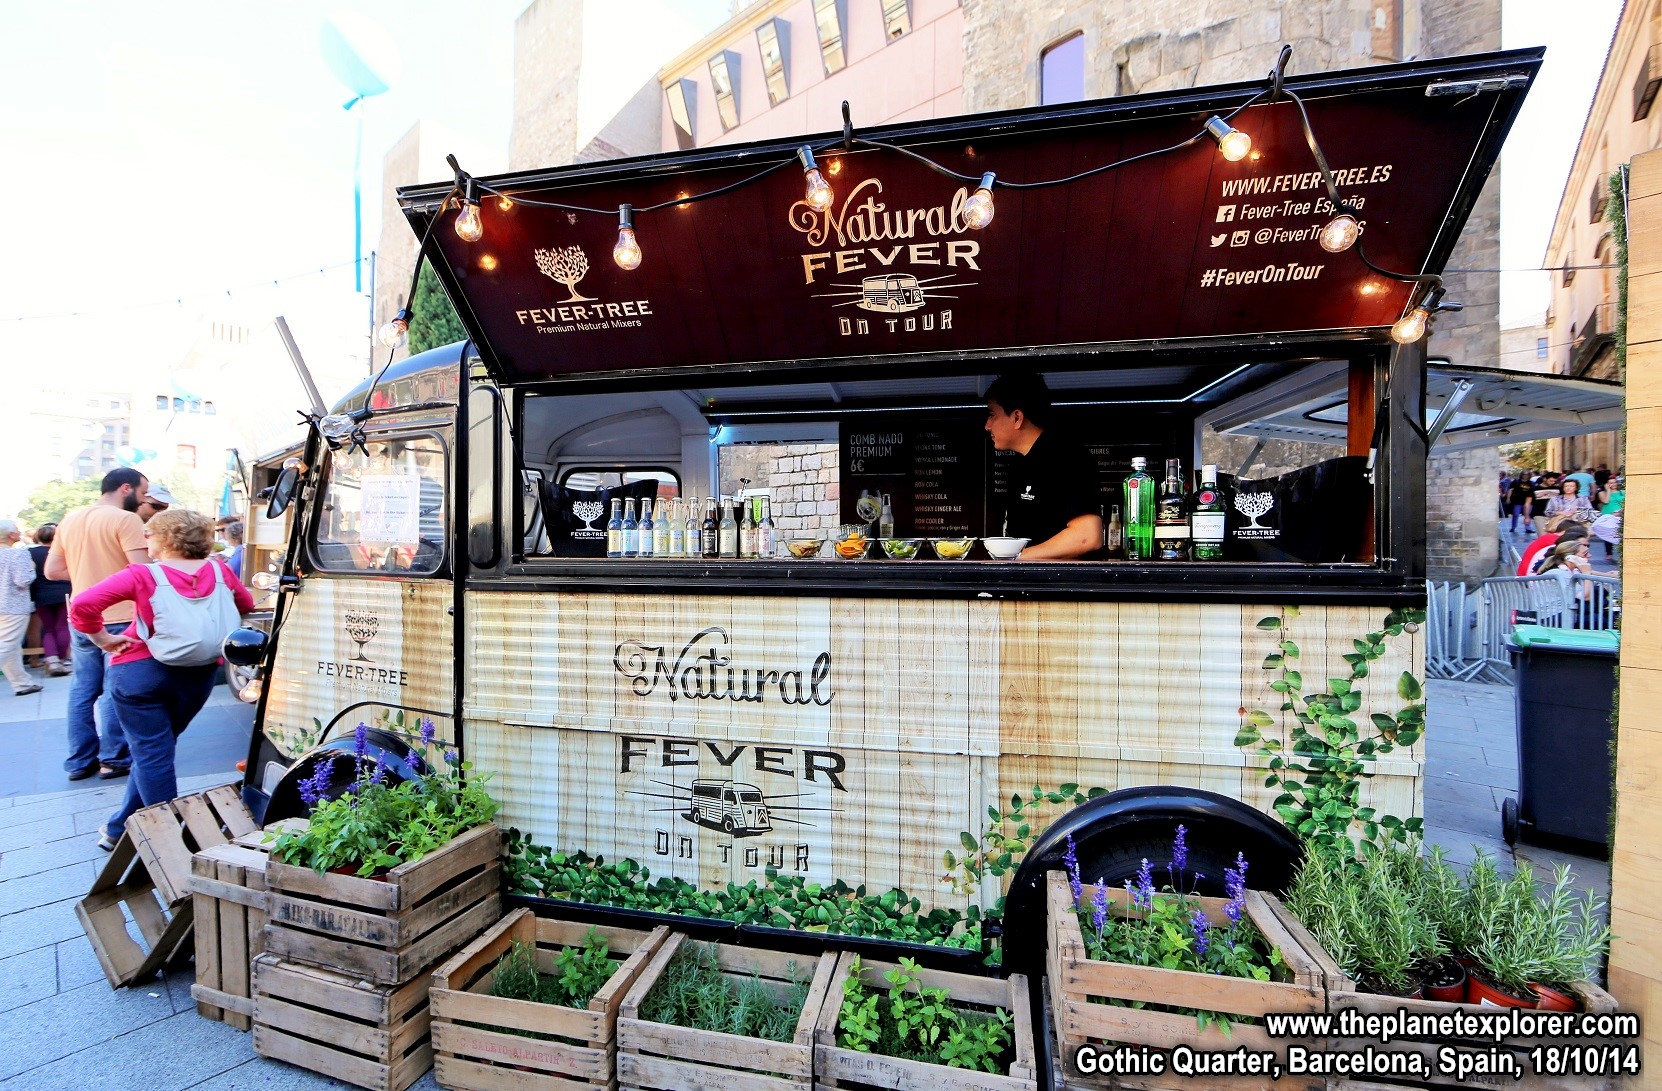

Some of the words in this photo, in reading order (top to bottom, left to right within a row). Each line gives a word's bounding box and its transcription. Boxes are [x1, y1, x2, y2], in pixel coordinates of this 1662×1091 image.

[788, 177, 973, 247] Natural
[1239, 200, 1310, 220] Fever-Tree
[801, 240, 981, 285] FEVER
[1200, 262, 1325, 288] #FeverOnTour
[515, 299, 653, 325] FEVER-TREE
[885, 309, 953, 333] TOUR
[536, 324, 576, 335] Premium
[577, 320, 610, 332] Natural
[611, 318, 642, 330] Mixers
[850, 433, 903, 445] COMBNADO
[850, 445, 892, 458] PREMIUM
[850, 459, 865, 472] 6€
[317, 661, 408, 687] FEVER-TREE
[613, 626, 836, 706] Natural
[620, 735, 848, 792] FEVER
[717, 843, 809, 872] TOUR
